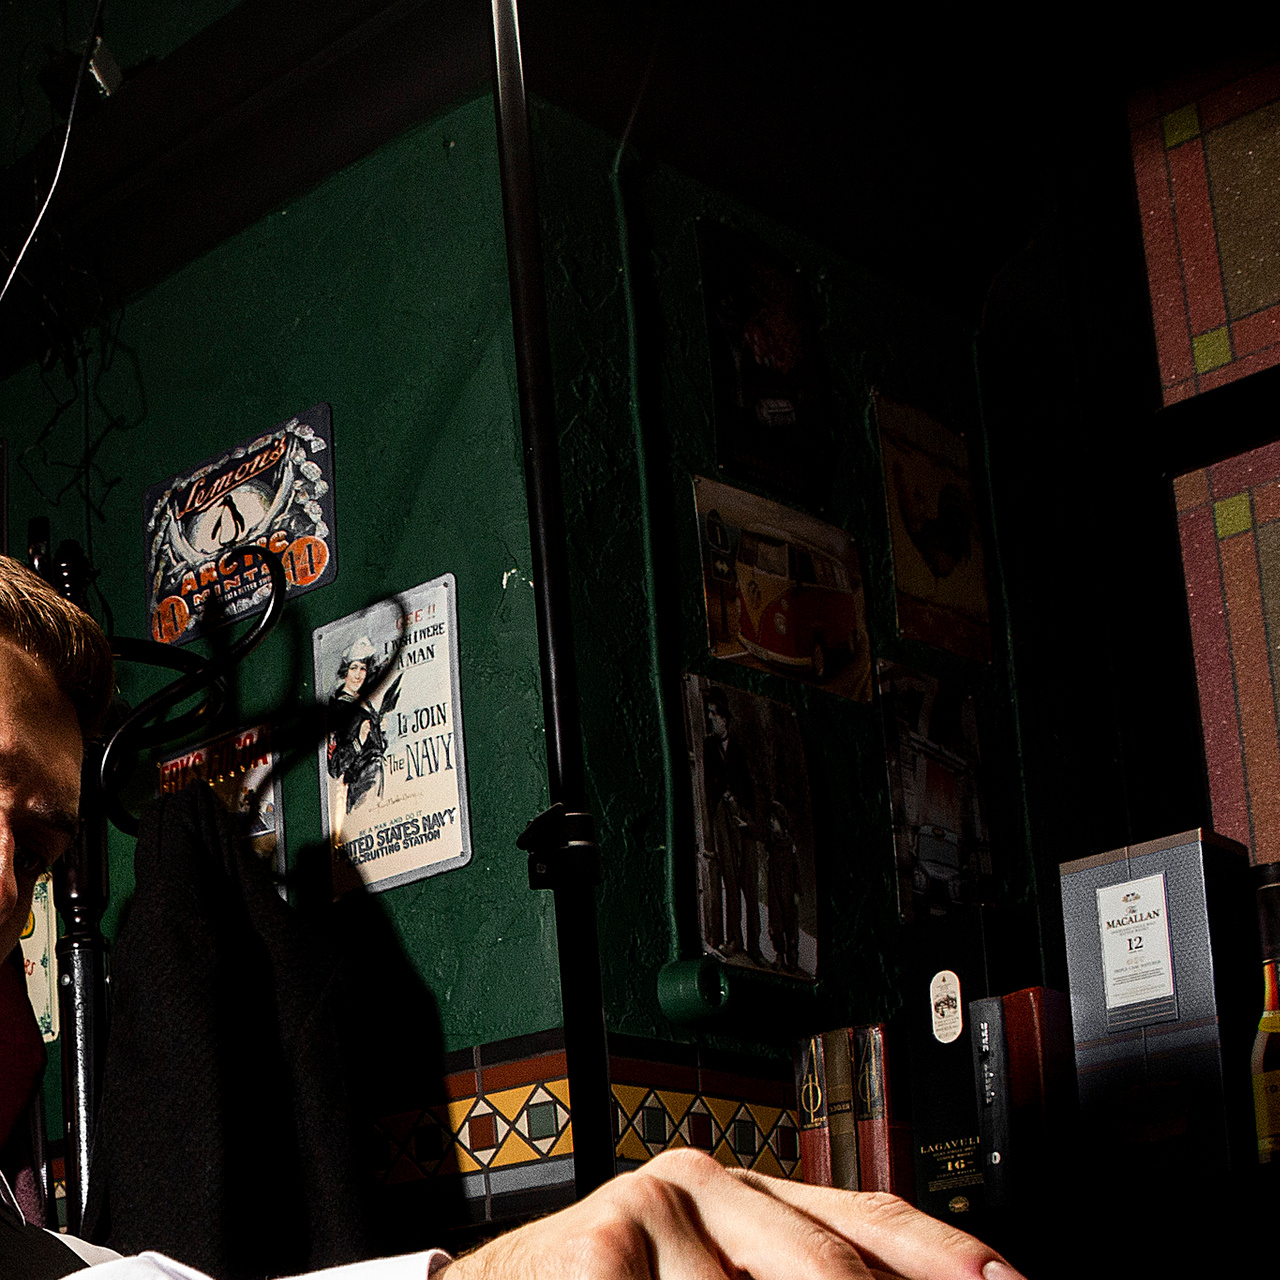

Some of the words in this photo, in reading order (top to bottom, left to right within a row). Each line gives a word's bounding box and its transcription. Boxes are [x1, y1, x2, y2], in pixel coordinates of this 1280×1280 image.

[419, 621, 446, 642] WERE
[406, 643, 436, 668] MAN
[411, 702, 448, 737] JOIN
[387, 752, 405, 776] The
[404, 732, 455, 782] NAVY
[340, 833, 375, 858] NITED
[376, 817, 421, 848] STATES
[422, 806, 457, 833] NAVY
[348, 841, 402, 867] ECRUITING
[402, 827, 442, 850] STATION
[1106, 908, 1162, 932] MACALLAN
[1127, 935, 1145, 952] 12
[919, 1135, 981, 1155] LAGAVULI
